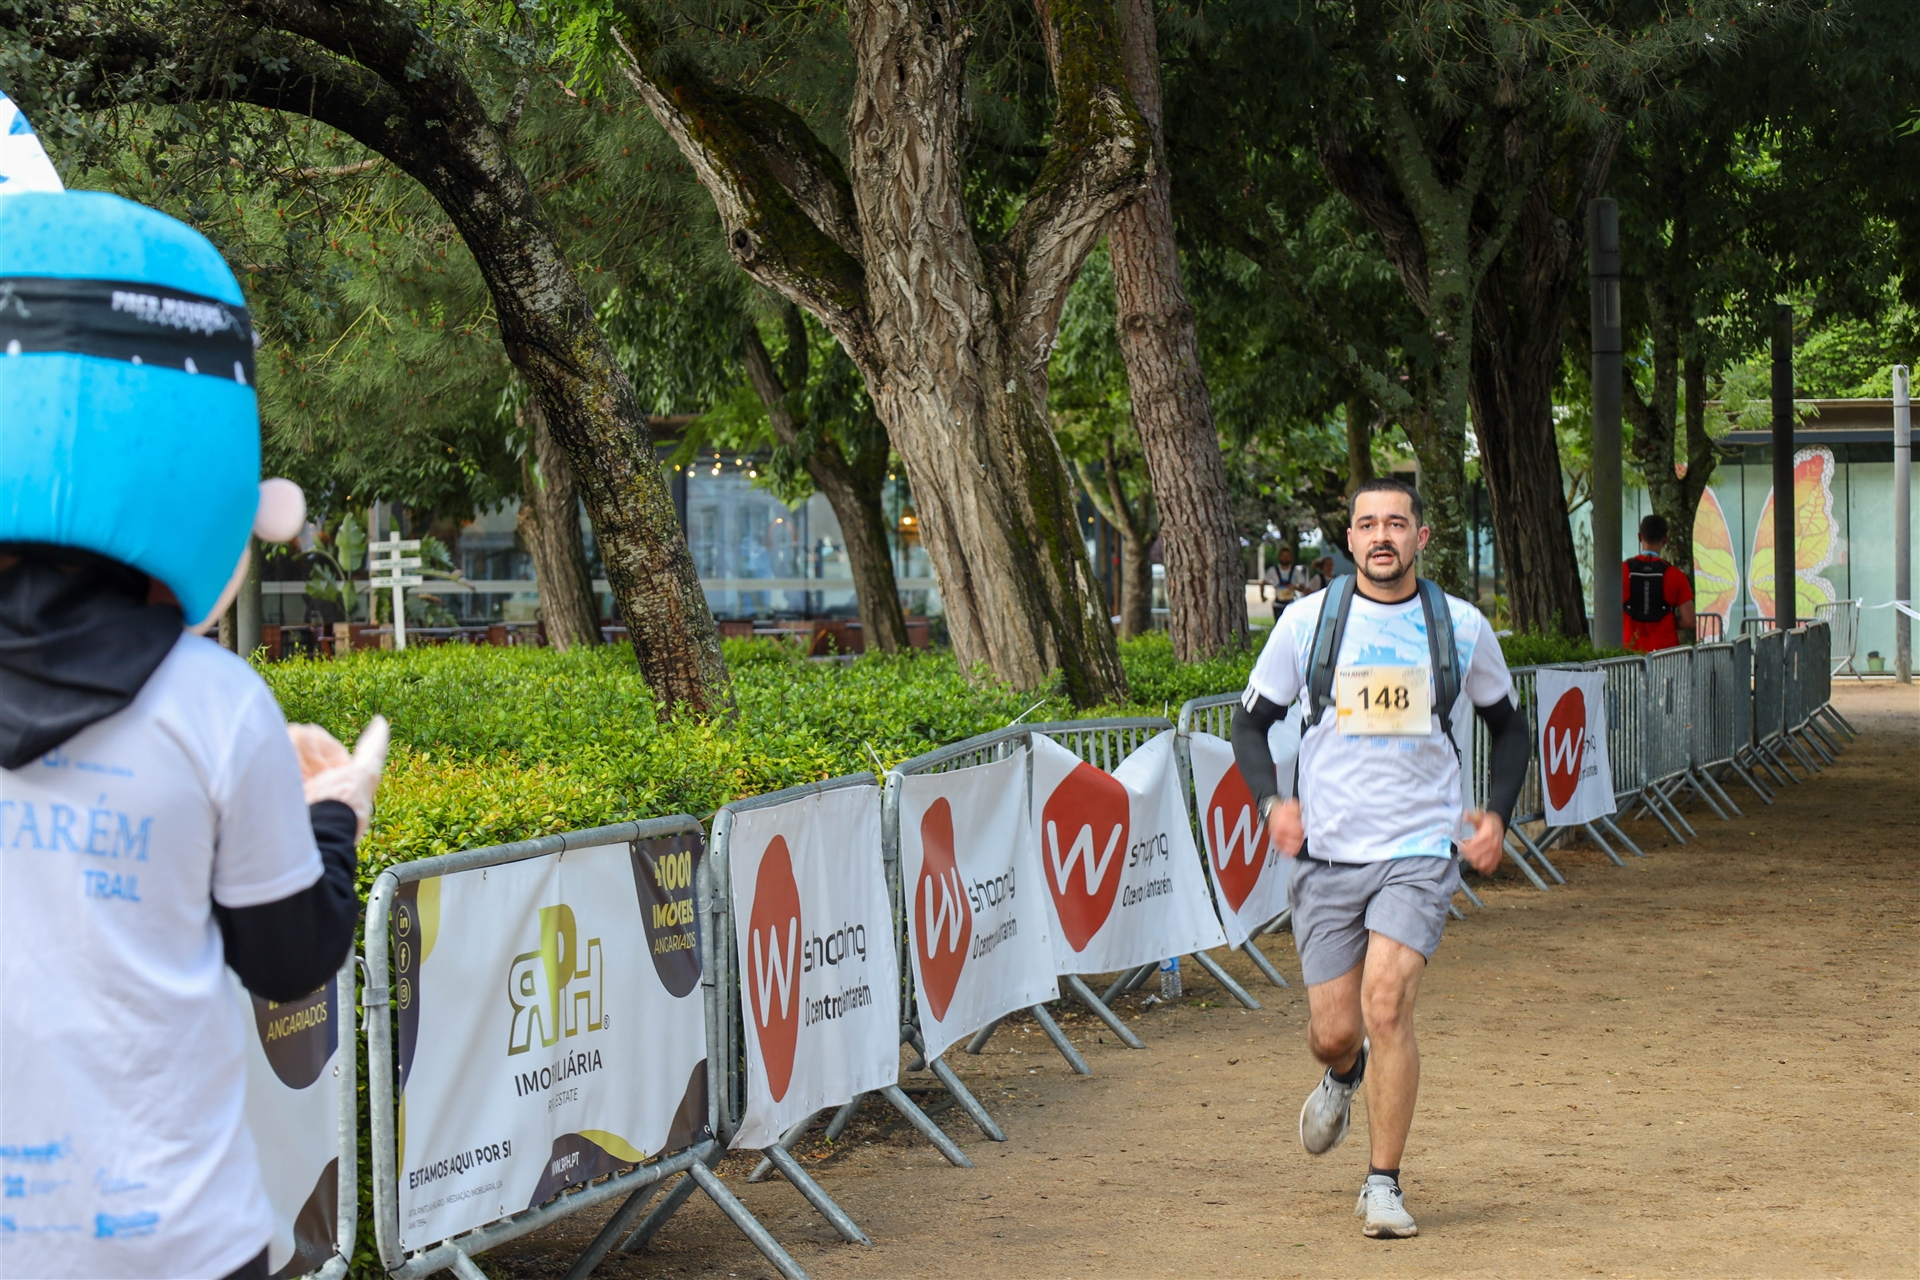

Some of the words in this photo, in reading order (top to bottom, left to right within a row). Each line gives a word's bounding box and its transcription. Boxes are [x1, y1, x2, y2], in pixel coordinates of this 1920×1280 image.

[1357, 685, 1410, 711] 148
[83, 870, 142, 902] TRAIL
[266, 1001, 329, 1042] ANGARIADOS
[409, 1159, 448, 1190] ESTAMOS
[449, 1151, 475, 1175] AQUI
[475, 1143, 501, 1166] POR
[502, 1140, 512, 1158] SI
